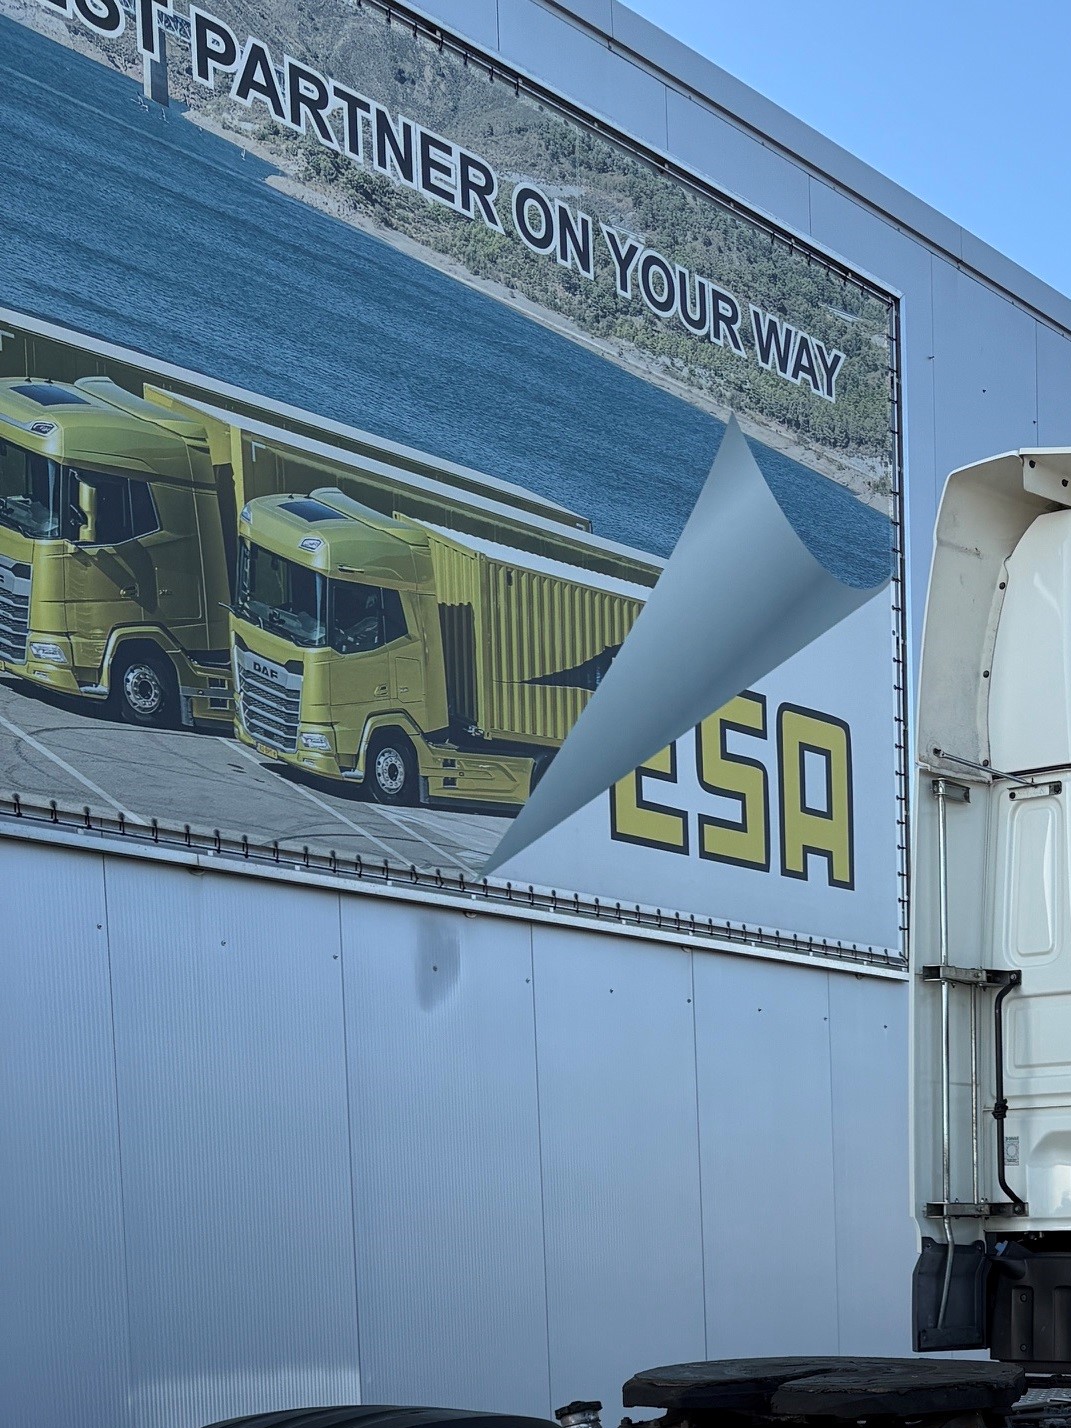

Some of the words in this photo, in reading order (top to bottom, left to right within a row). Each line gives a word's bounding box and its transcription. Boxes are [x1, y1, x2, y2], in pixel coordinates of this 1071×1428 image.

[192, 8, 502, 233] PARTNER
[513, 184, 593, 278] ON
[601, 224, 745, 357] YOUR
[750, 305, 845, 401] WAY
[253, 661, 278, 680] DAF
